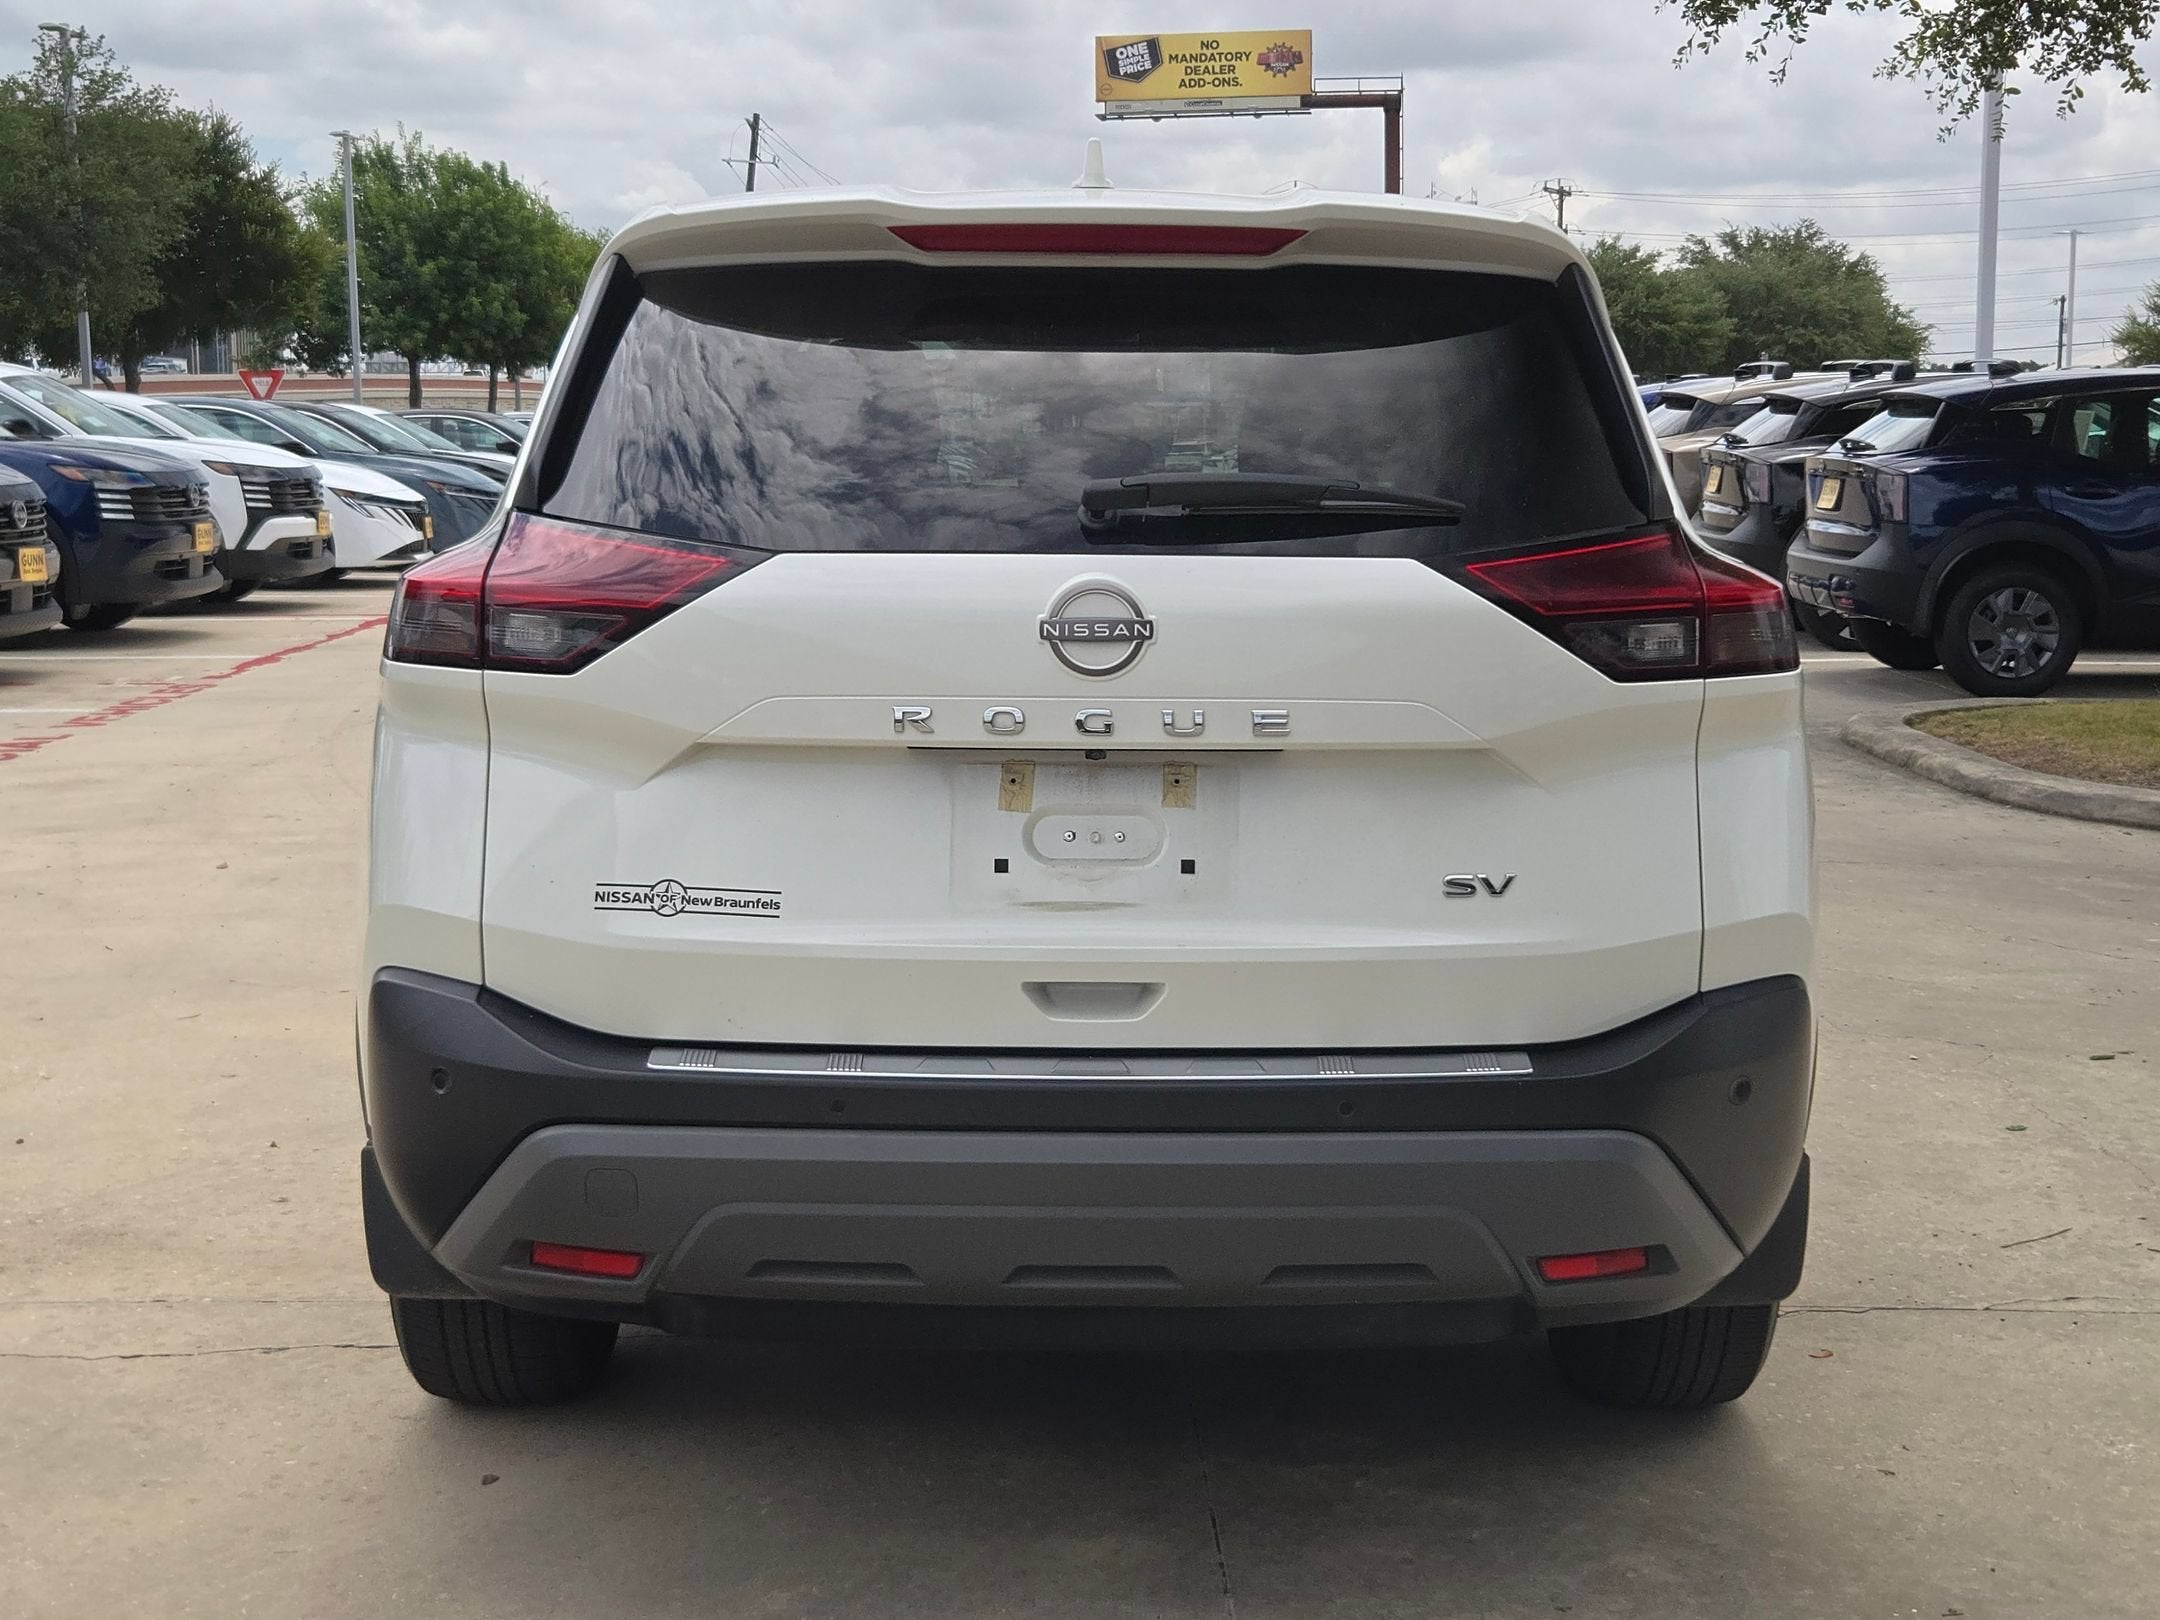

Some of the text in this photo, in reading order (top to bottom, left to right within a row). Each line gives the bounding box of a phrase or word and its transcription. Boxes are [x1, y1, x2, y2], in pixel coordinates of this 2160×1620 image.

[1116, 42, 1149, 59] ONE
[1200, 40, 1220, 50] NO
[1118, 54, 1150, 67] SIMPLE
[1168, 51, 1252, 64] MANDATORY
[1119, 61, 1152, 76] PRICE
[1184, 64, 1236, 76] DEALER
[1178, 77, 1243, 89] ADD-ONS.
[22, 552, 44, 567] GUNN
[1043, 623, 1151, 637] NISSAN
[893, 705, 1291, 737] ROGUE
[1442, 873, 1517, 898] SV
[594, 890, 781, 910] NISSAN OF New Braunfels
